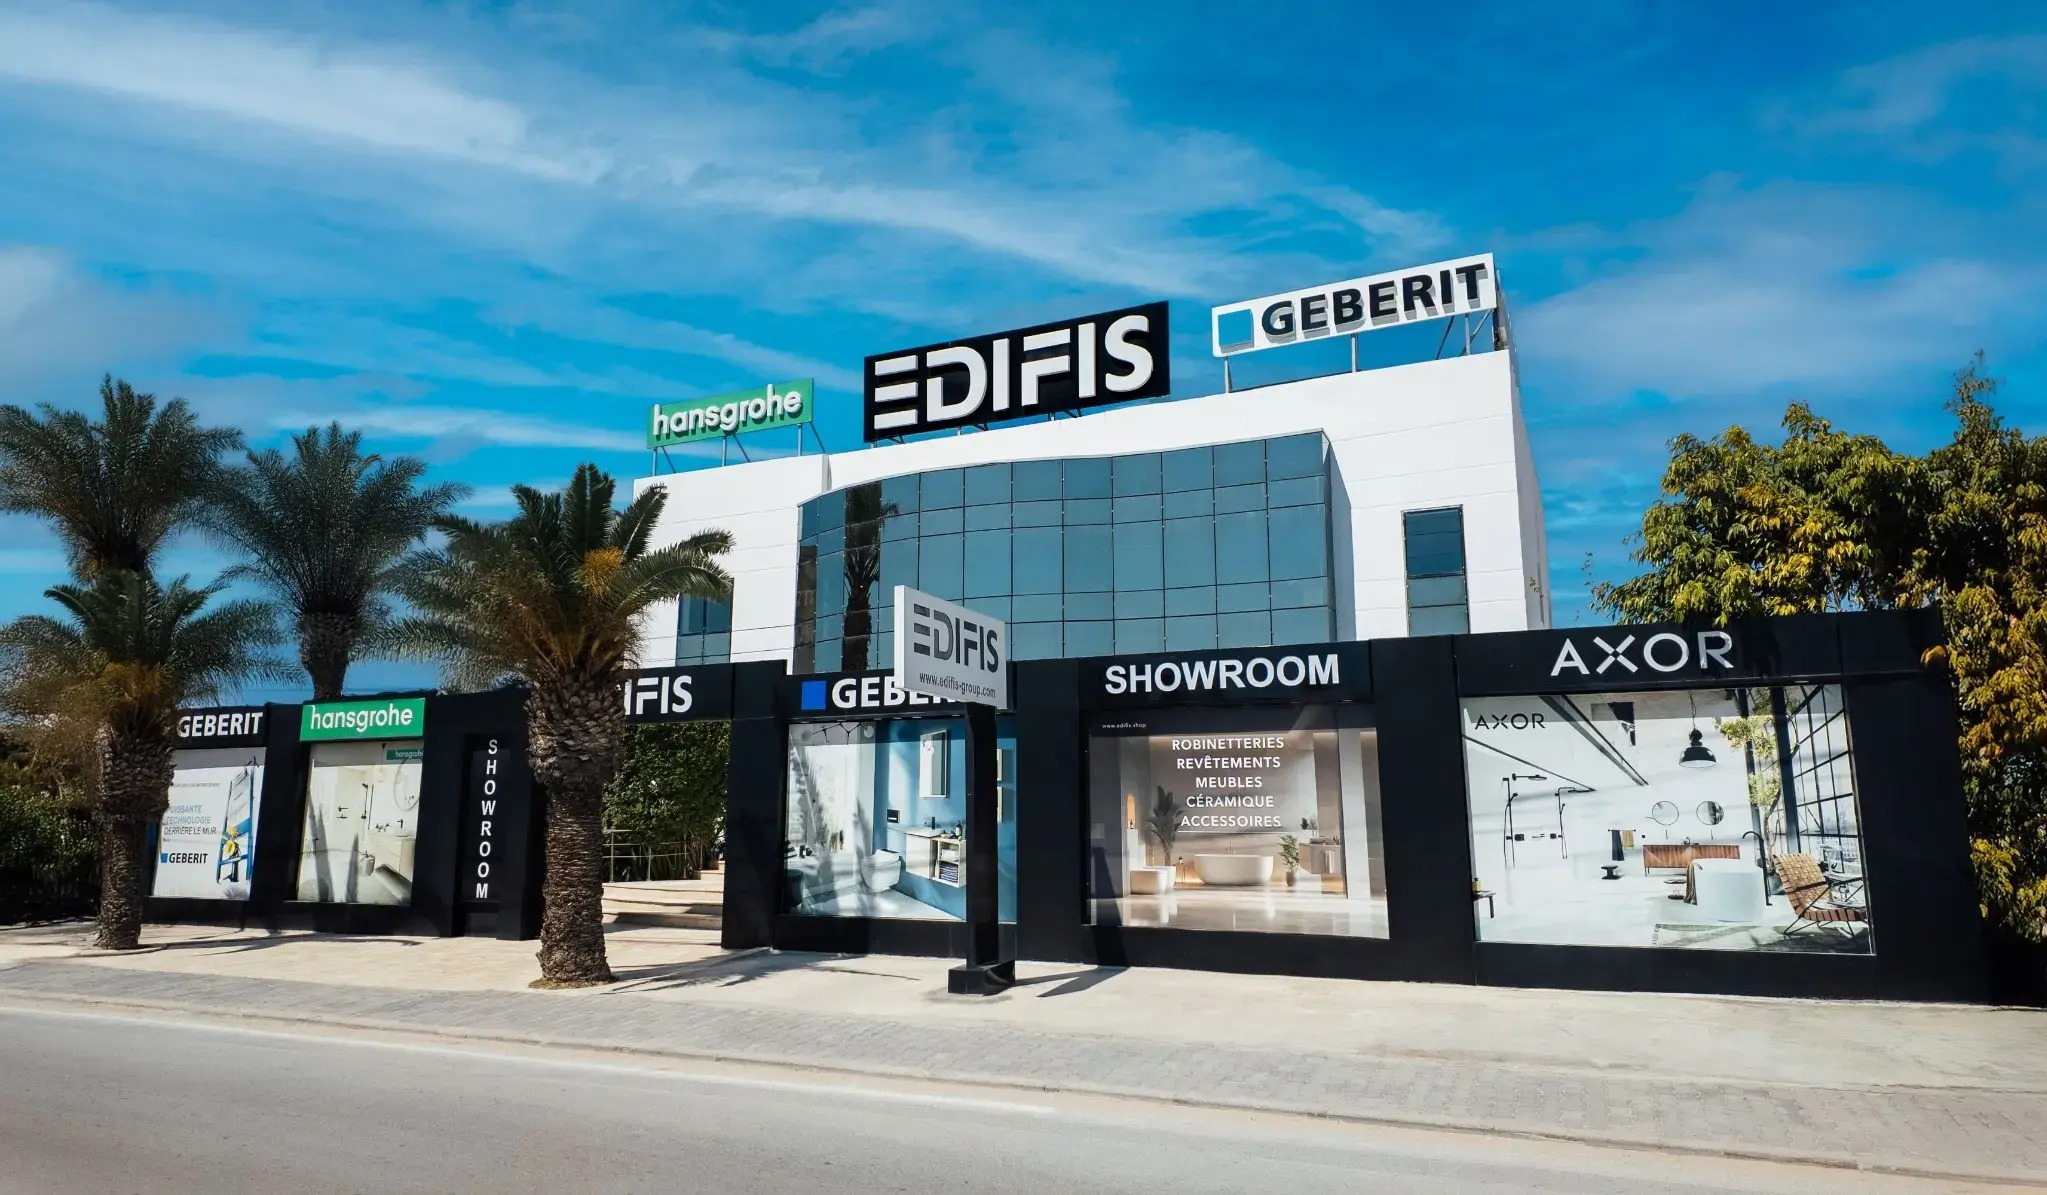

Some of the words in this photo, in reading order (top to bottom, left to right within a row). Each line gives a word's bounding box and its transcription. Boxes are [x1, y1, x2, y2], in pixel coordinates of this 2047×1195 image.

[1261, 263, 1487, 337] GEBERIT
[873, 315, 1153, 430] EDIFIS
[653, 384, 802, 432] hansgrohe
[914, 603, 999, 674] EDIFIS
[1550, 631, 1735, 676] AXOR
[919, 672, 996, 699] www.edifis-group.com
[1105, 653, 1340, 694] SHOWROOM
[176, 712, 264, 738] GEBERIT
[310, 704, 413, 733] hansgrohe
[1474, 713, 1545, 730] AXOR
[395, 749, 424, 759] hansgroh
[1172, 736, 1285, 751] ROBINETTERIES
[1176, 755, 1281, 769] REVÊTEMENTS
[1195, 776, 1263, 788] MEUBLES
[1186, 793, 1275, 809] CÉRAMIQUE
[193, 826, 203, 835] LE
[202, 826, 217, 835] MUR
[475, 739, 498, 899] SHOWROOM
[1180, 815, 1282, 828] ACCESSOIRES
[168, 853, 209, 864] GEBERIT
